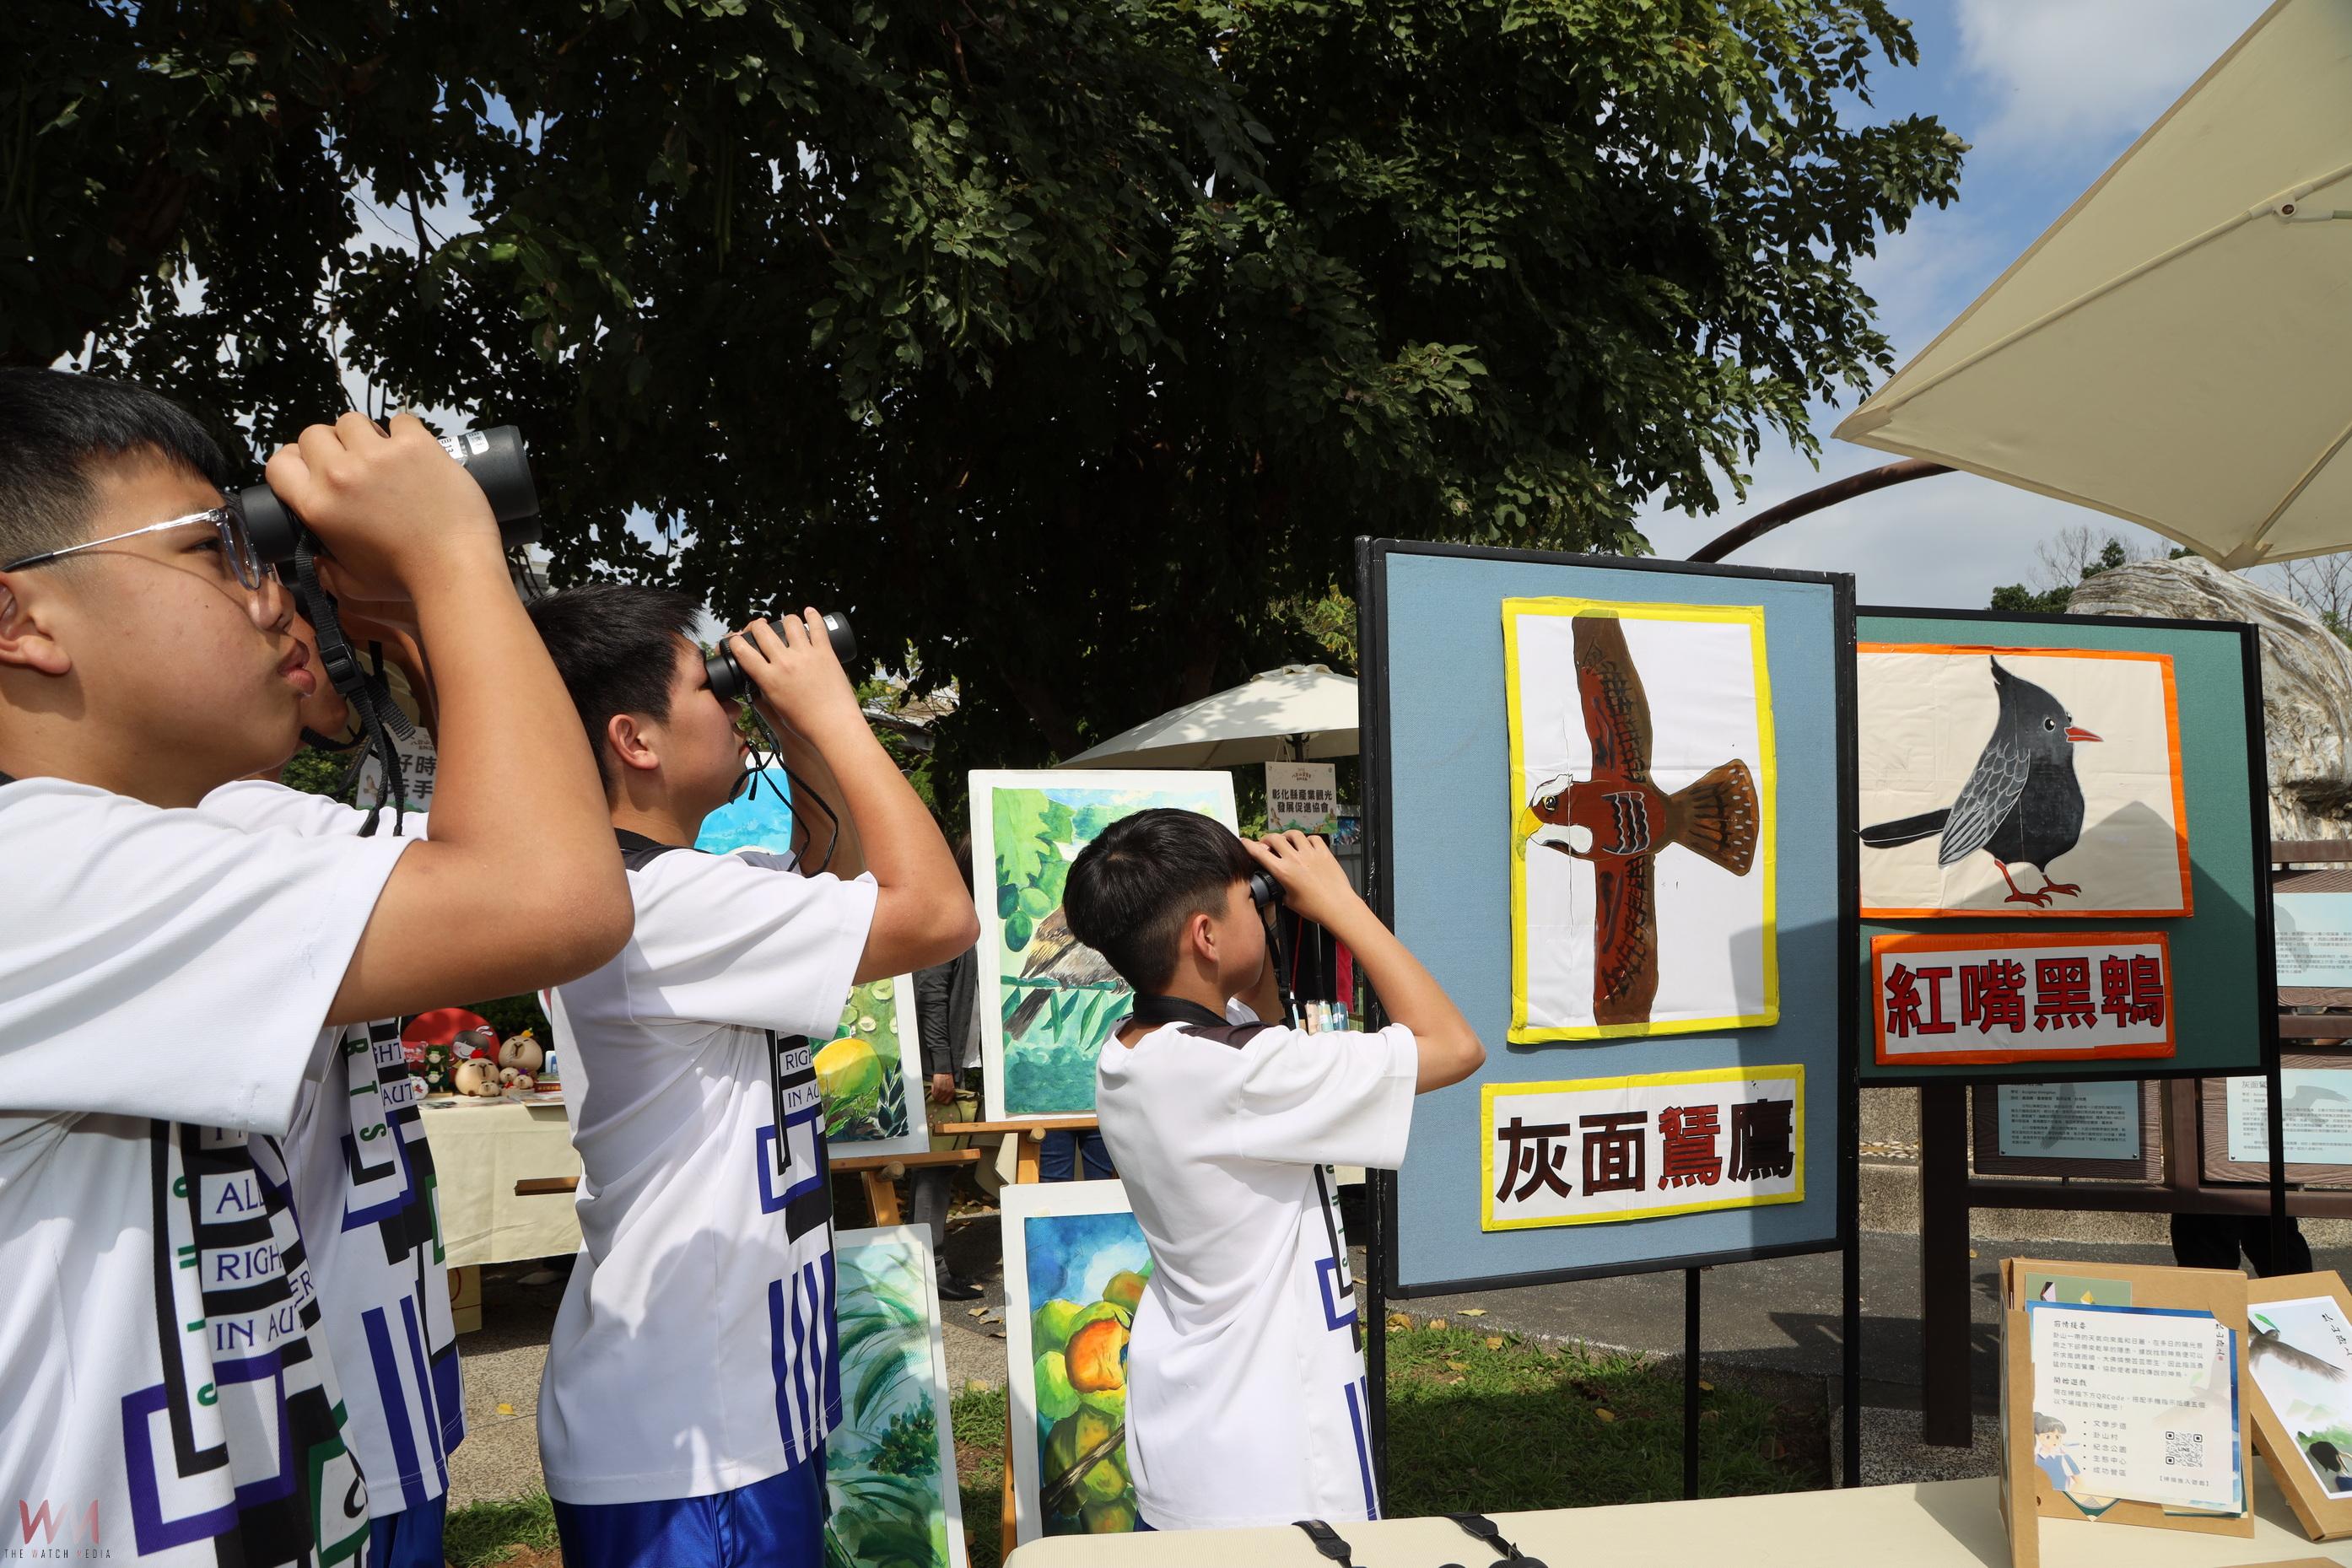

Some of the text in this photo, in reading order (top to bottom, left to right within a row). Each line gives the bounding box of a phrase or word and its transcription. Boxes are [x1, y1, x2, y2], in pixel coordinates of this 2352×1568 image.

[1272, 789, 1333, 800] 彰化縣產業觀光
[1277, 802, 1329, 813] 發展促進協會
[1885, 954, 2164, 1037] 紅嘴黑鵯
[787, 1090, 801, 1108] IN
[1496, 1099, 1796, 1204] 灰面鵟鷹
[216, 1320, 254, 1351] IN
